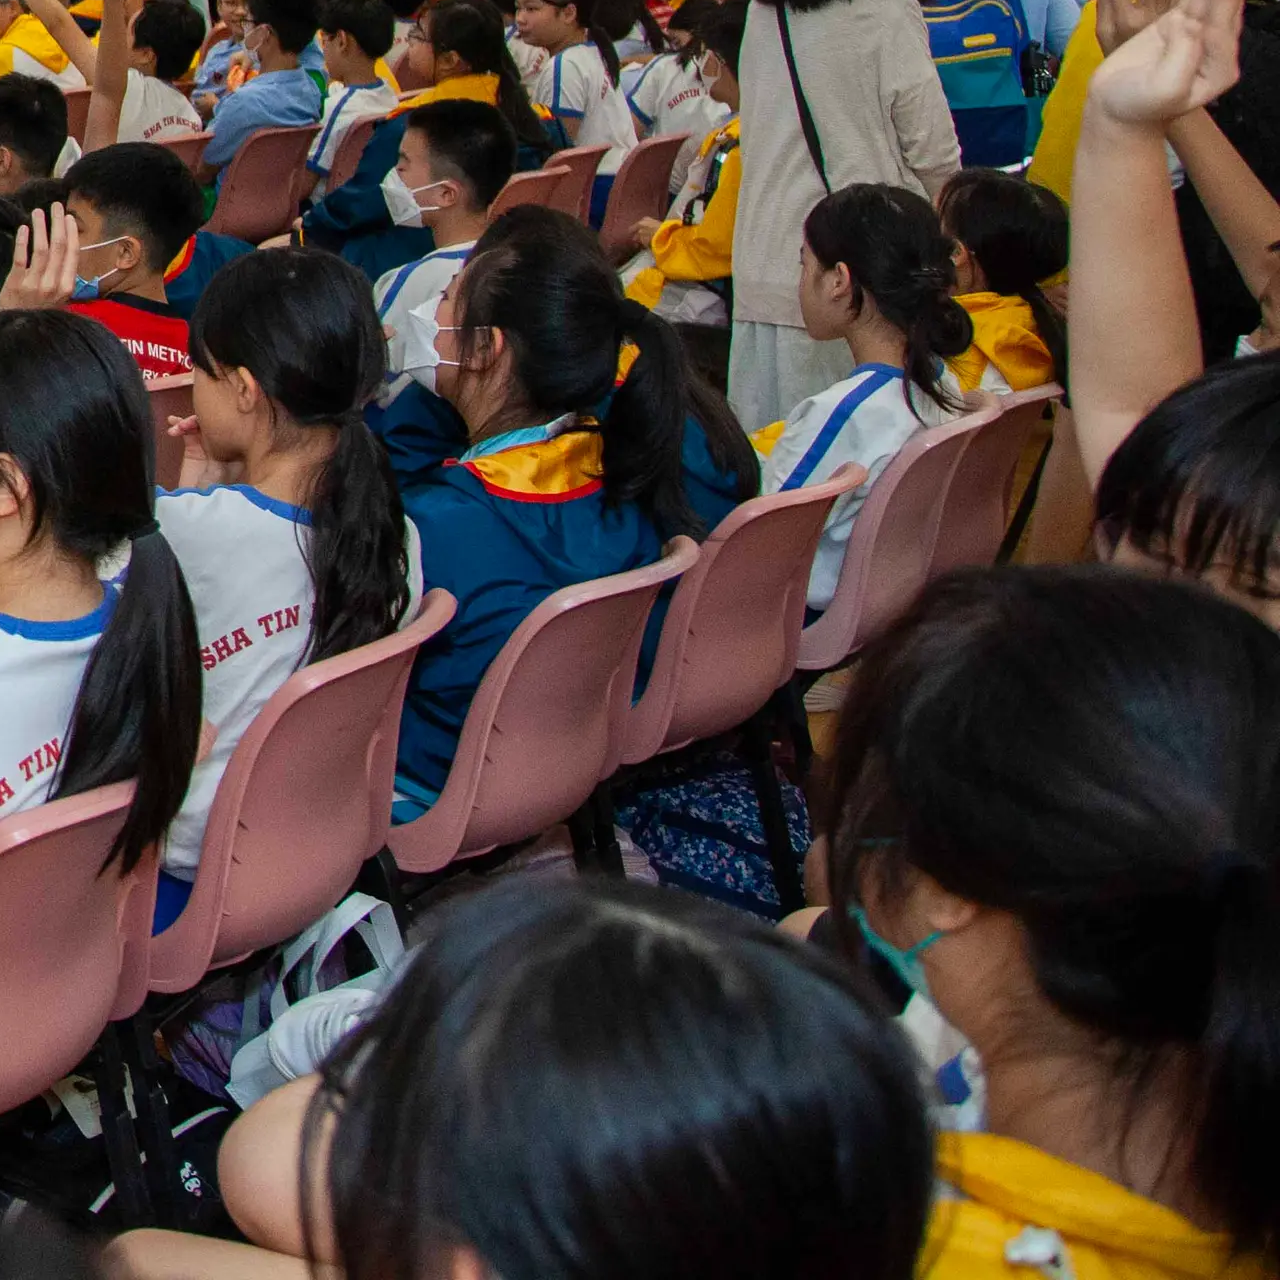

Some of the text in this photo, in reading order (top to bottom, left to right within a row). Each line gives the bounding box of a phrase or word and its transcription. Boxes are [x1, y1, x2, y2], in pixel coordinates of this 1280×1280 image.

[200, 604, 301, 671] SHA TIN
[19, 737, 62, 782] TIN
